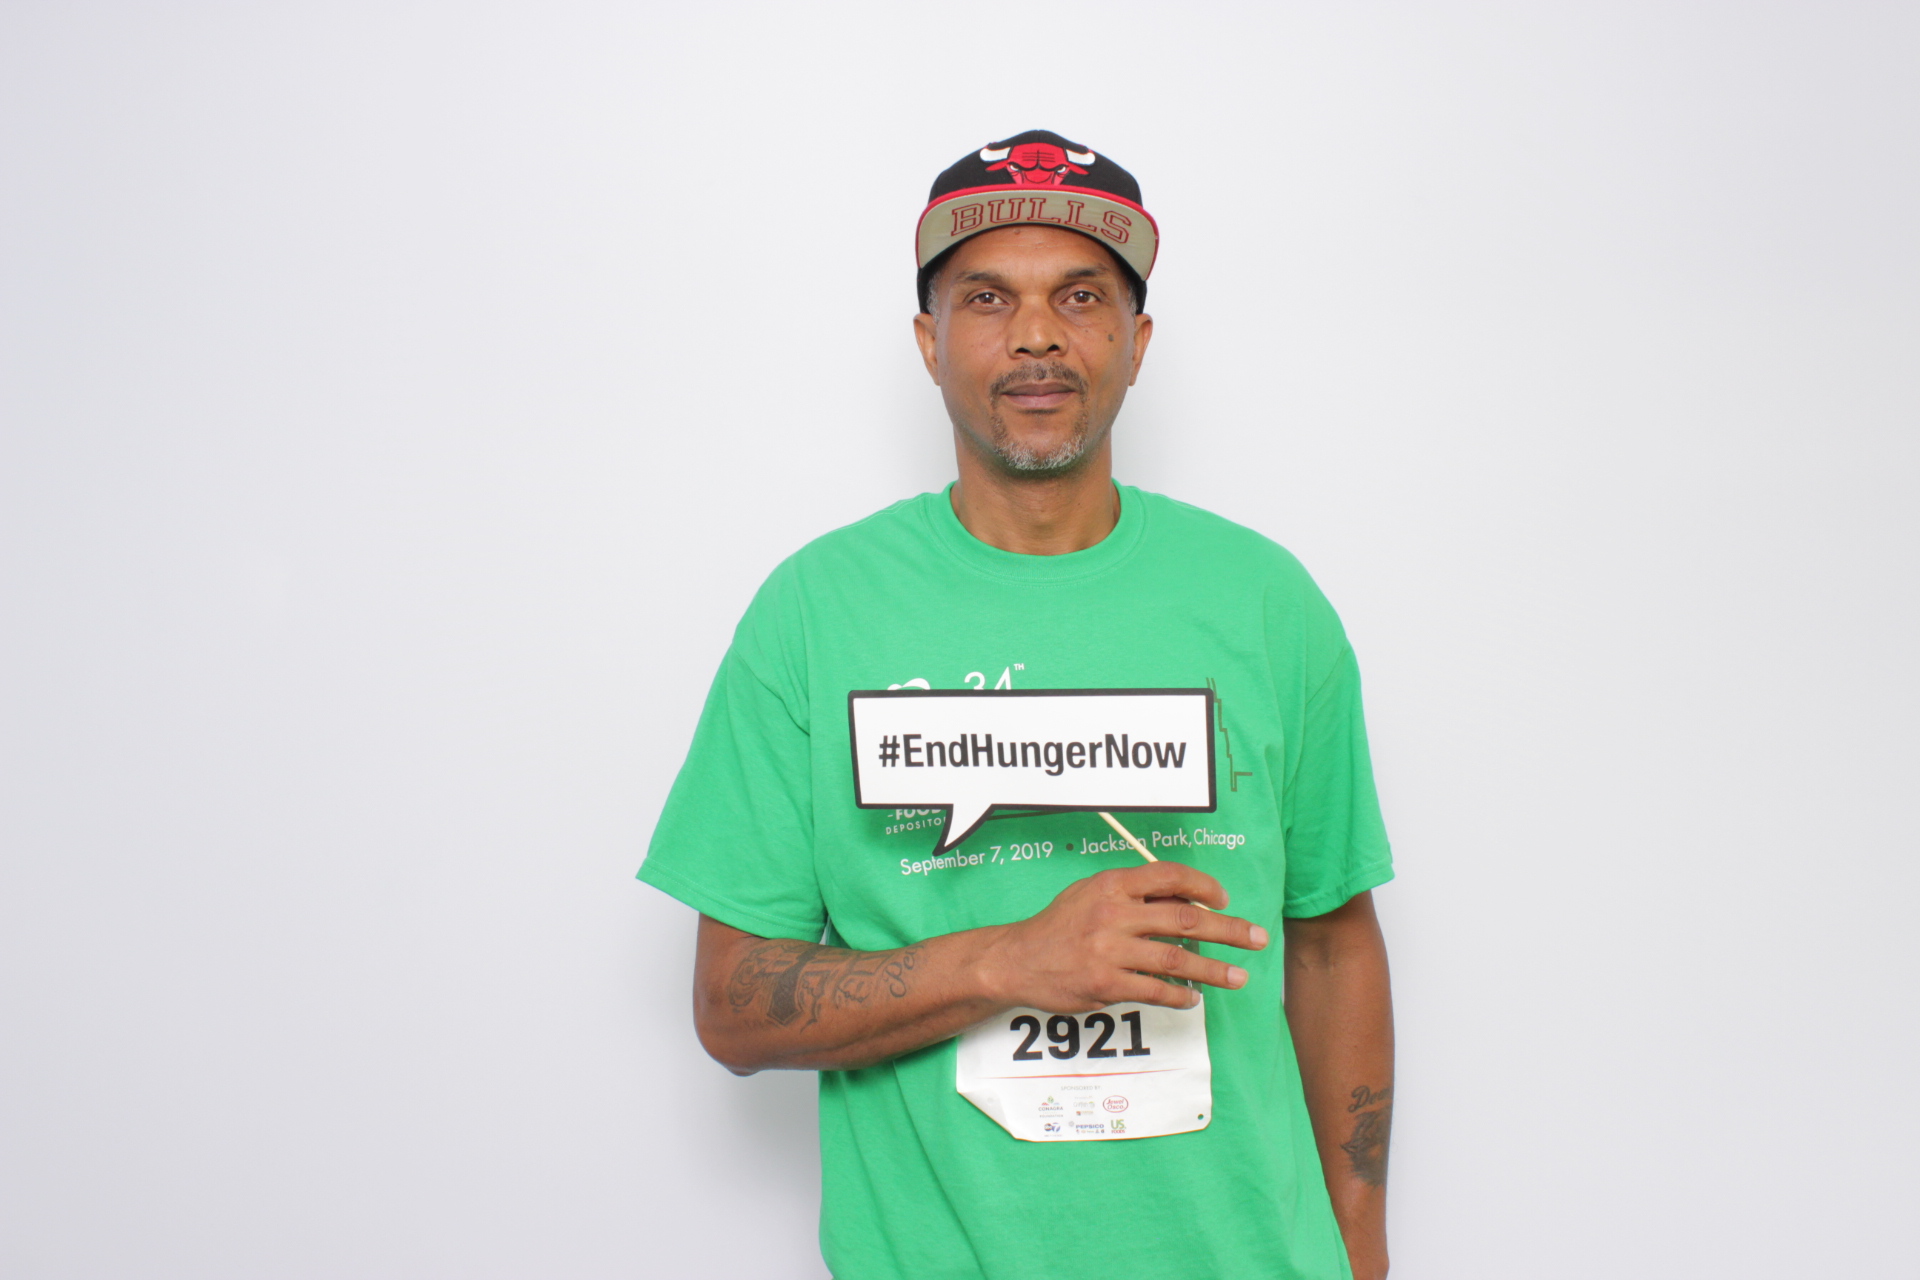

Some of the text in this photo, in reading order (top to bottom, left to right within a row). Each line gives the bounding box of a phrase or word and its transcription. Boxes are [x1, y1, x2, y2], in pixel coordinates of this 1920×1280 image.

[950, 197, 1132, 244] BULLS
[878, 733, 1187, 777] #EndHungerNow
[885, 816, 946, 835] DEPOSITO
[901, 850, 985, 876] September
[990, 846, 1004, 865] 7,
[1010, 841, 1054, 861] 2019
[1193, 827, 1246, 850] Chicago
[1009, 1010, 1151, 1062] 2921
